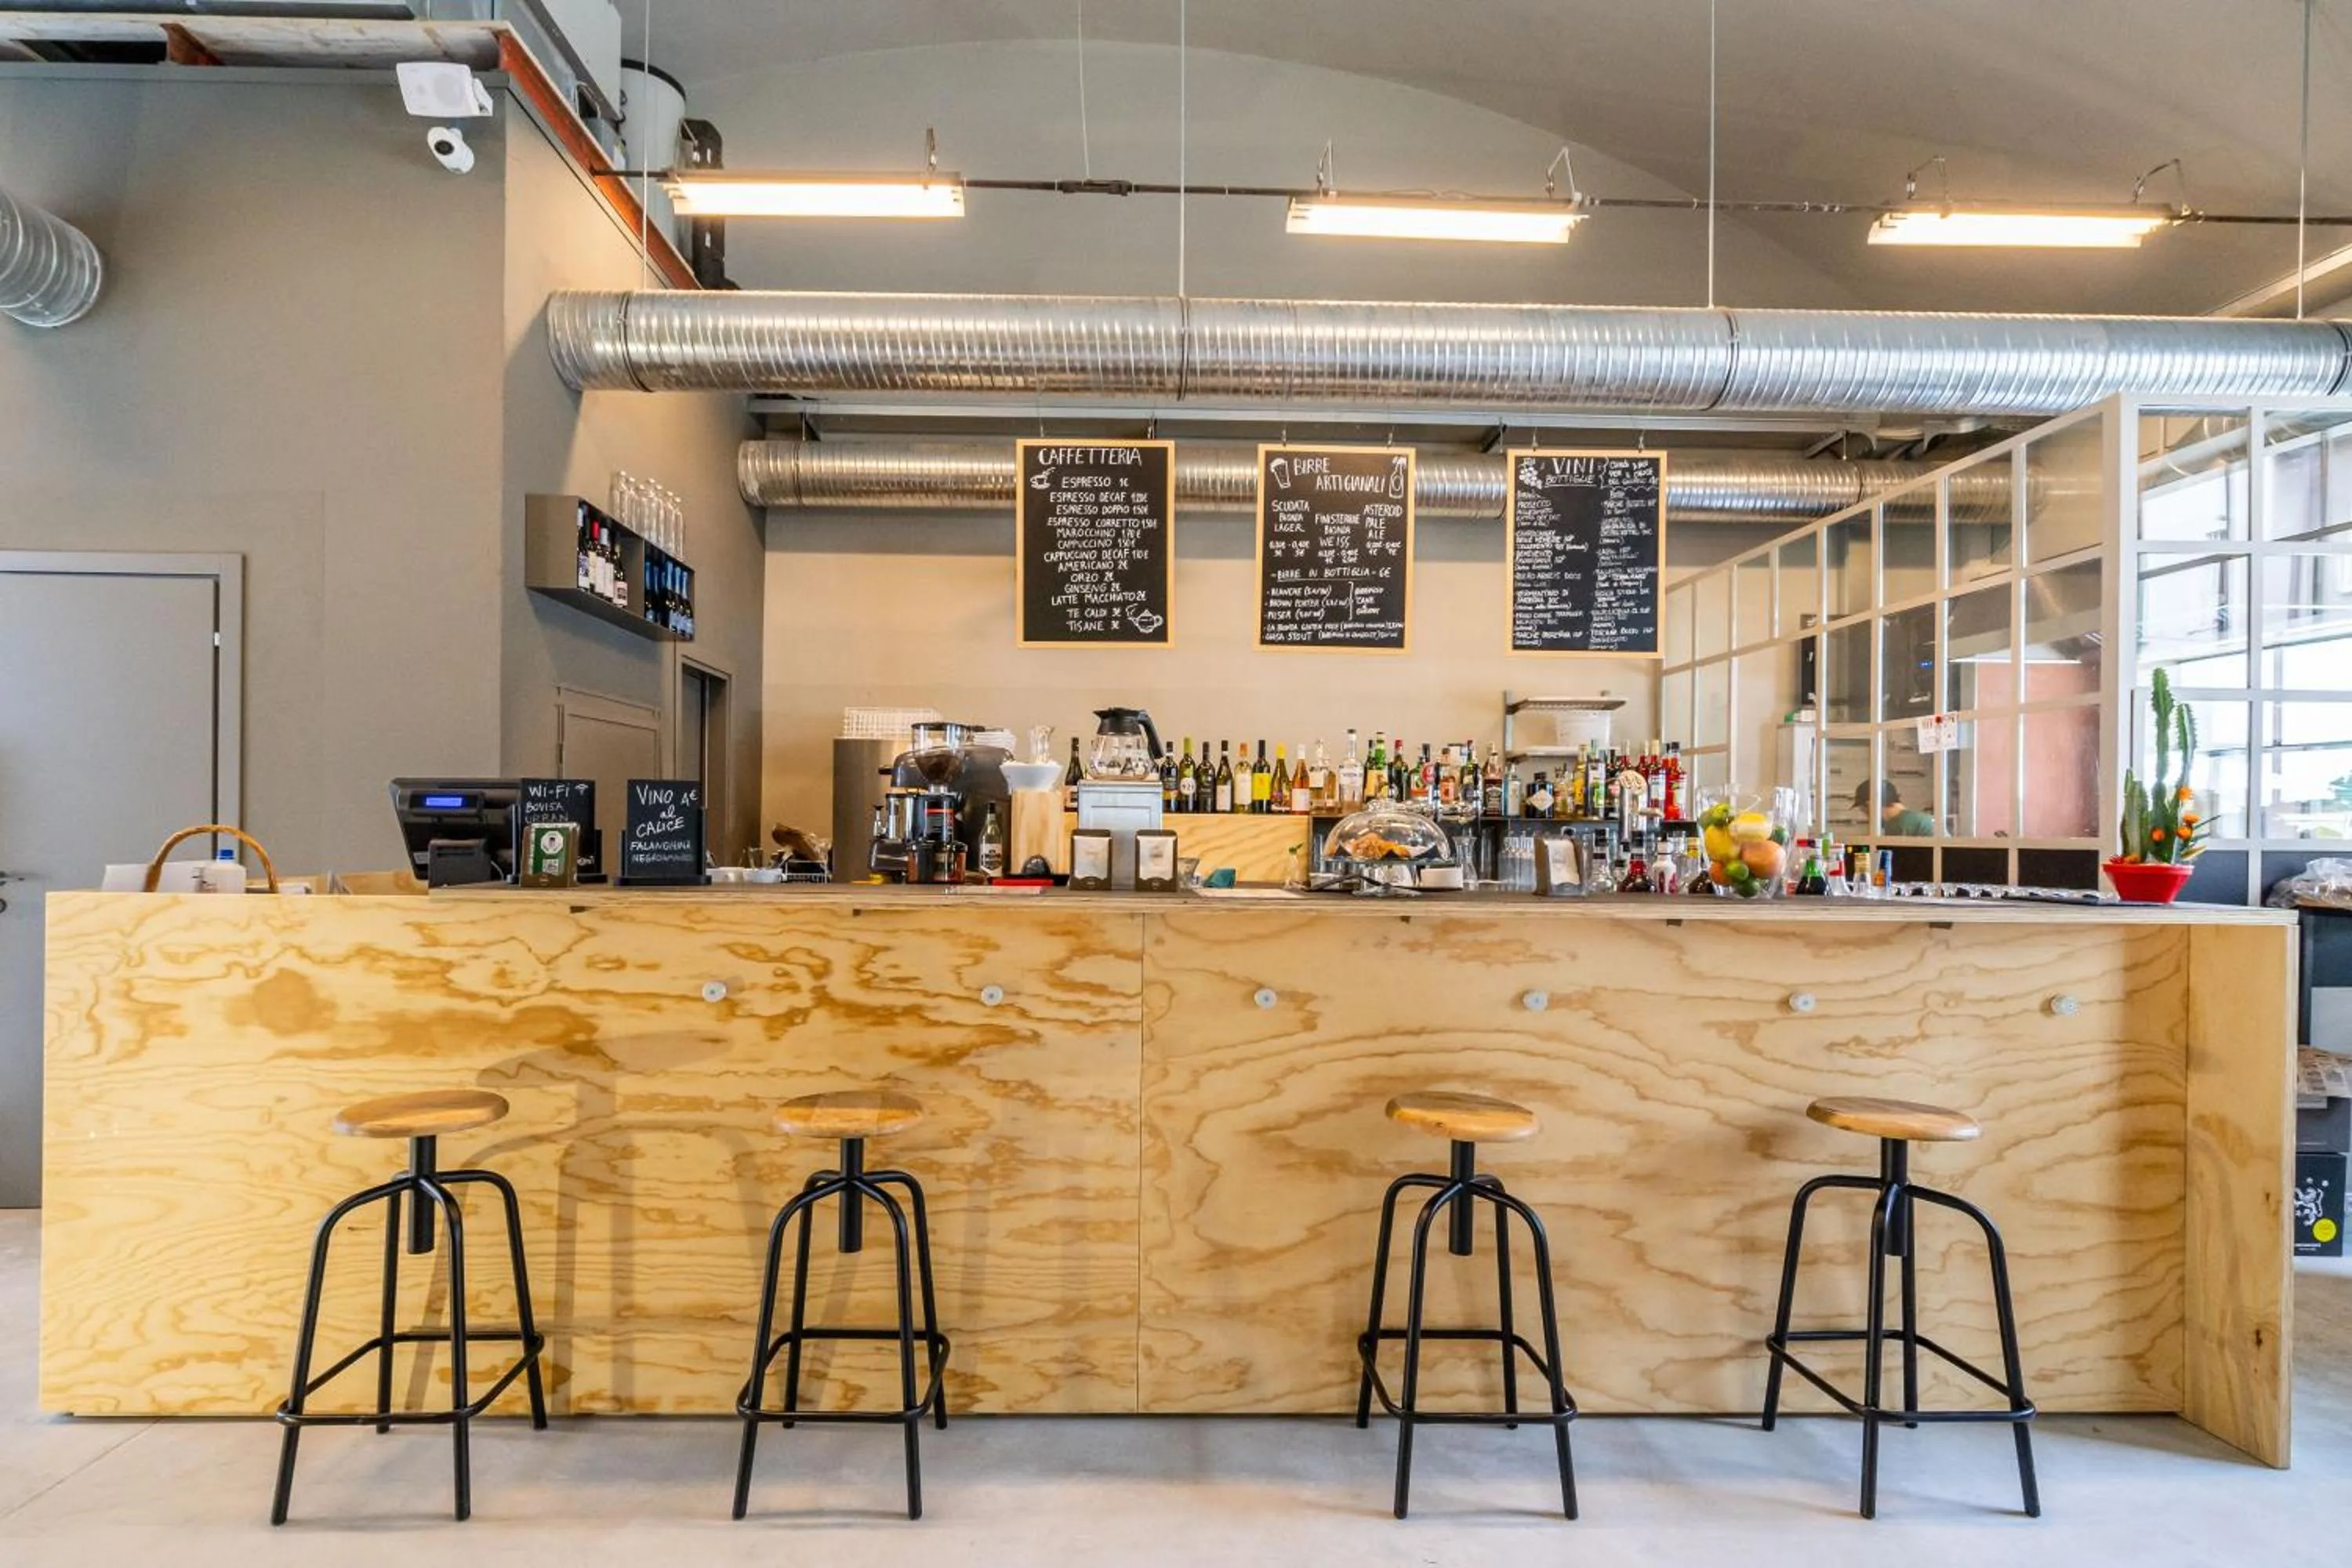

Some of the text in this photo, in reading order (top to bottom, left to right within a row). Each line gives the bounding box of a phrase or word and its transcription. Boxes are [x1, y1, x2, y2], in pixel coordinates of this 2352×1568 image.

[1038, 448, 1142, 466] CAFFETTERIA
[1294, 457, 1330, 476] BIRRE
[1552, 457, 1595, 474] VINI
[1062, 476, 1111, 488] ESPRESSO
[1316, 474, 1386, 493] ARTIGIANALI
[1545, 474, 1595, 484] BOTTIGLIE
[1050, 492, 1095, 503] ESPRESSO
[1099, 492, 1127, 503] DECAF
[1056, 504, 1098, 515] ESPRESSO
[1102, 505, 1130, 515] DOPPIO
[1363, 504, 1403, 517] ASTEROID
[1047, 517, 1091, 527] ESPRESSO
[1095, 518, 1139, 528] CORRETTO
[1274, 523, 1305, 532] LAGER
[1365, 517, 1386, 528] PALE
[1056, 528, 1116, 539] MAROCCHINO
[1367, 529, 1385, 539] ALE
[1058, 539, 1112, 549] CAPPUCCINO
[1319, 535, 1351, 549] WEISS
[1044, 550, 1098, 562] CAPPUCCINO
[1102, 549, 1130, 560] DECAF
[1058, 561, 1114, 573] AMERICANO
[1276, 569, 1302, 579] BIRRE
[1308, 568, 1319, 578] IN
[1324, 567, 1370, 578] BOTTIGLIA
[1070, 572, 1098, 583] ORZO
[1064, 583, 1107, 594] GINSENG
[1051, 594, 1078, 606] LATTE
[1084, 592, 1135, 604] MACCHIATO
[1066, 620, 1105, 632] TISANE
[1287, 631, 1312, 641] STOUT
[636, 784, 673, 806] VINO
[525, 801, 564, 813] BOVISA
[637, 817, 684, 837] CALICE
[630, 840, 691, 851] FALANGHINA
